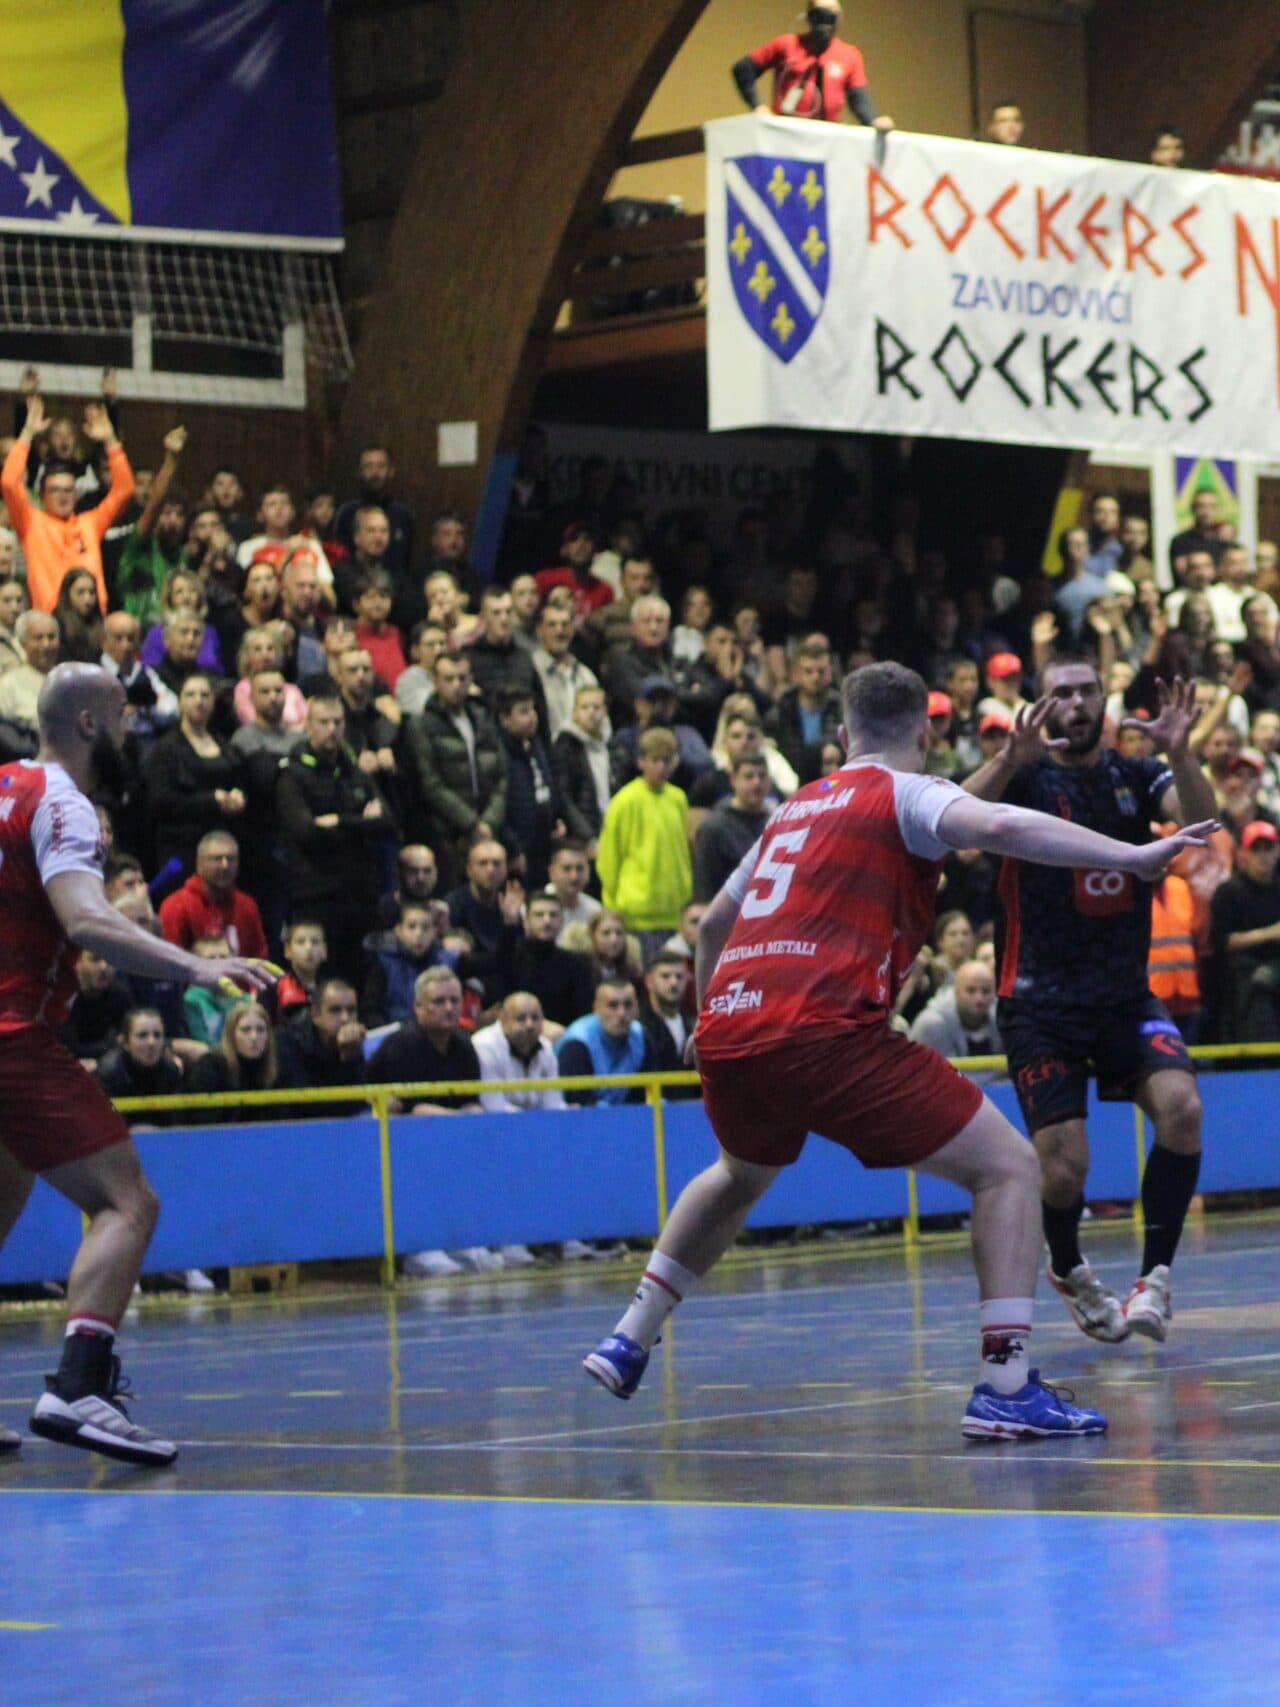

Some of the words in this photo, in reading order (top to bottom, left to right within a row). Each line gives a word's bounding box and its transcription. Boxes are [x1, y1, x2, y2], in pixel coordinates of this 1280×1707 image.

[866, 163, 1207, 280] ROCKERS
[874, 316, 1213, 424] ROCKERS
[740, 825, 811, 920] 5
